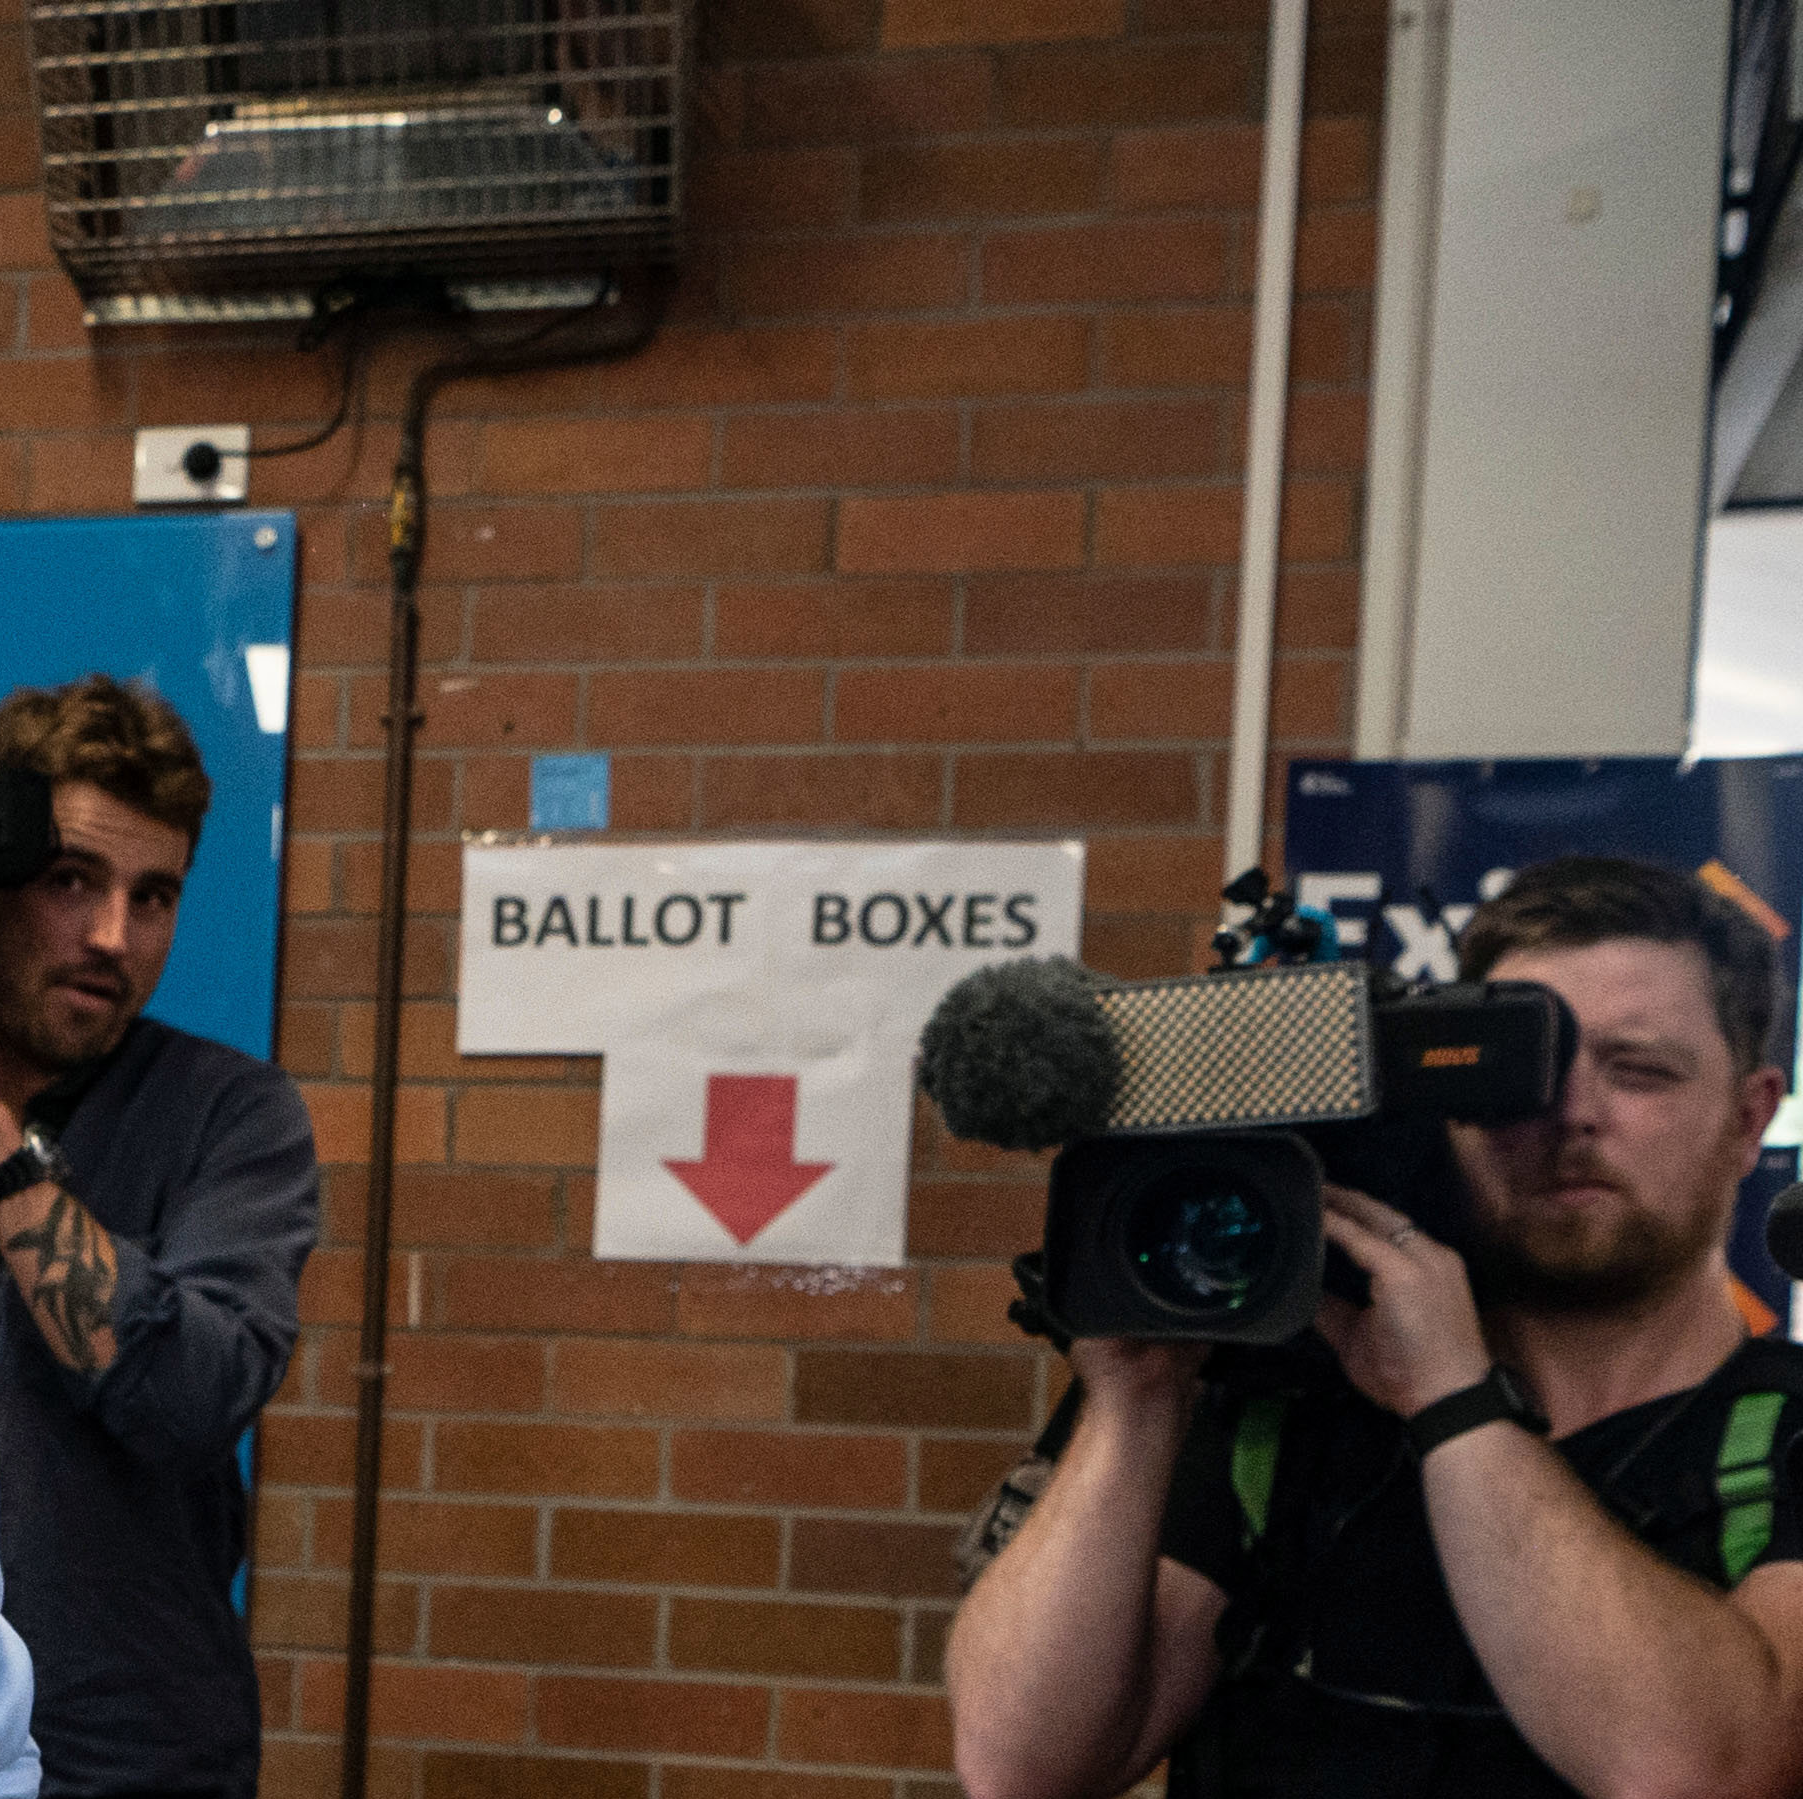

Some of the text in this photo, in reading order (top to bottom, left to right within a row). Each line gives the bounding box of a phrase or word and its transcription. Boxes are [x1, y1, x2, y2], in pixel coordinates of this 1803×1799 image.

[490, 891, 1039, 950] BALLOT BOXES
[1294, 868, 1517, 984] Ex
